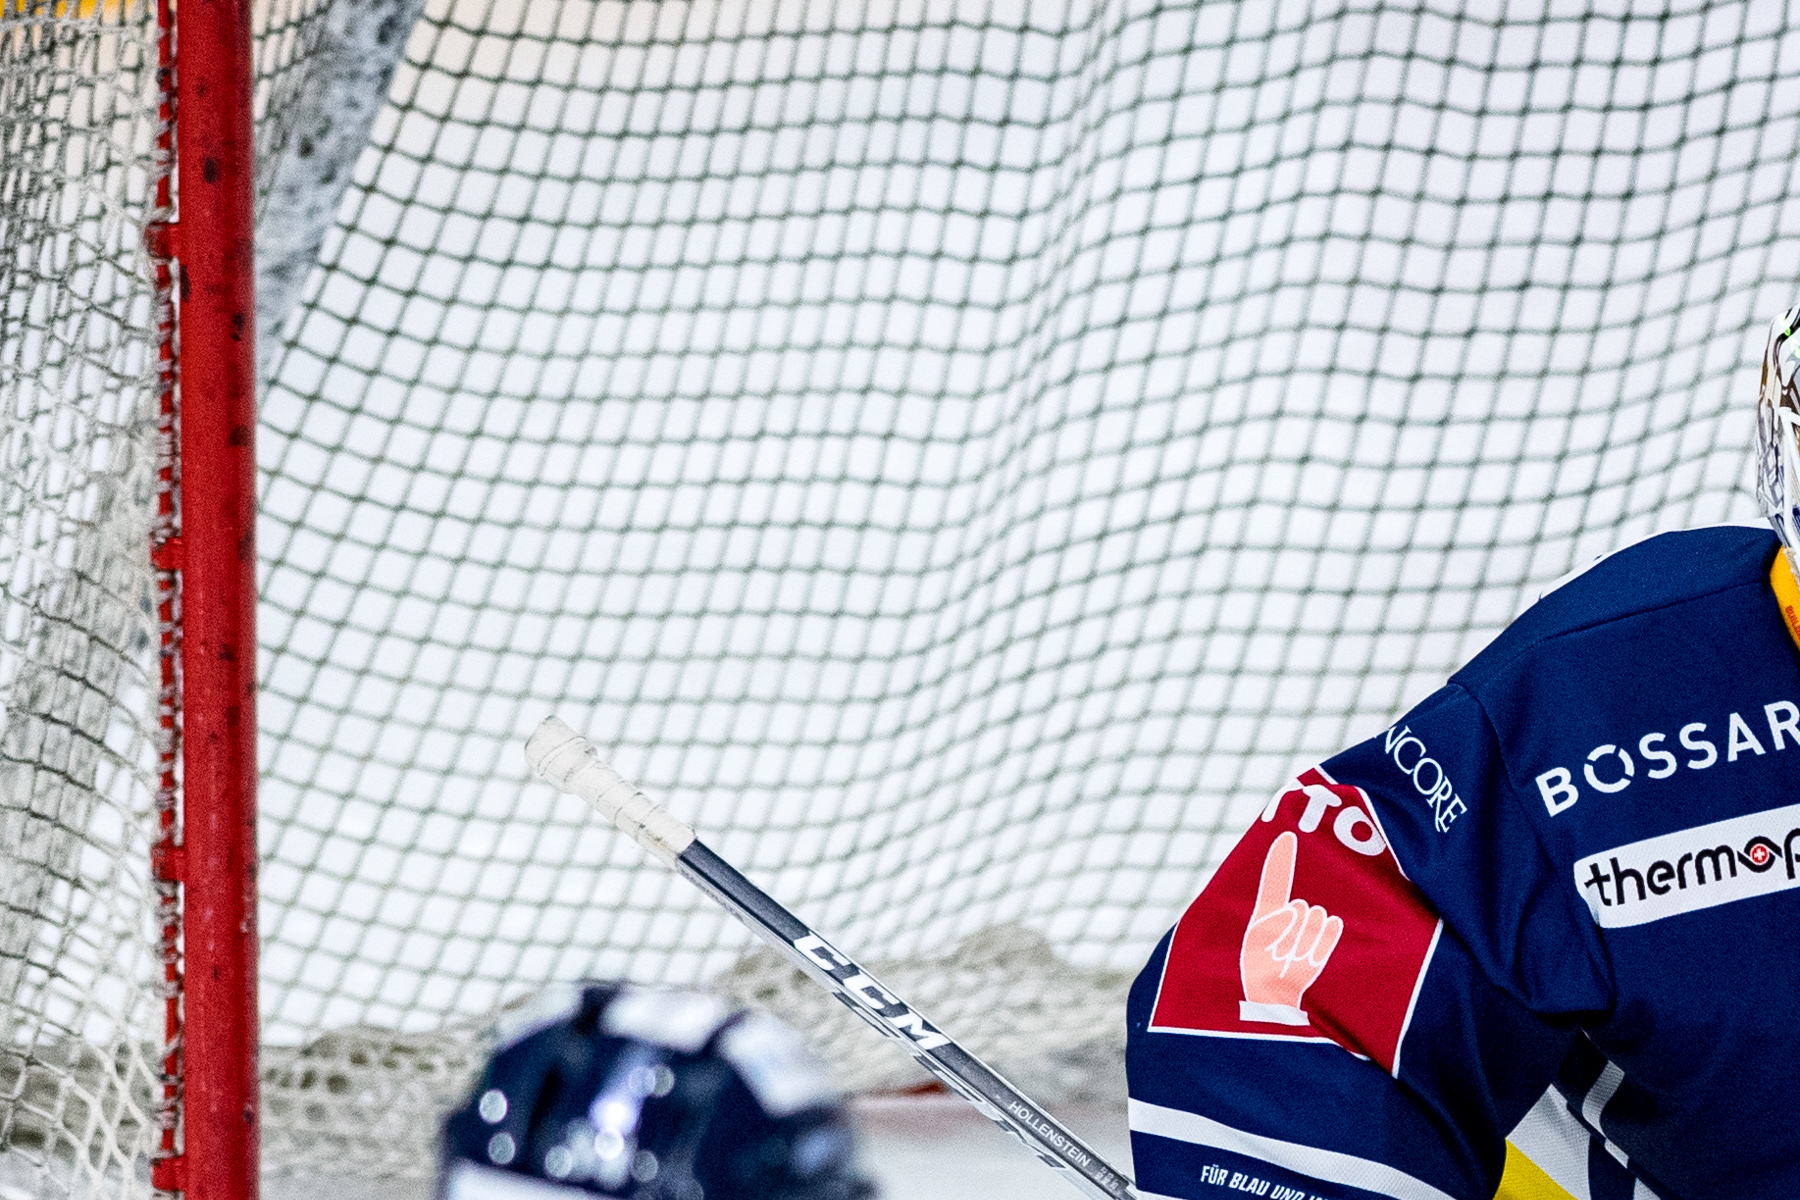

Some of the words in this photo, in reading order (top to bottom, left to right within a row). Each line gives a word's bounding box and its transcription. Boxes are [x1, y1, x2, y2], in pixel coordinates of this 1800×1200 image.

[1384, 725, 1469, 834] NCORE
[793, 930, 953, 1051] CCM
[1007, 1100, 1093, 1169] HOLLENSTEIN
[1200, 1163, 1229, 1187] FÜR
[1228, 1172, 1271, 1197] BLAU
